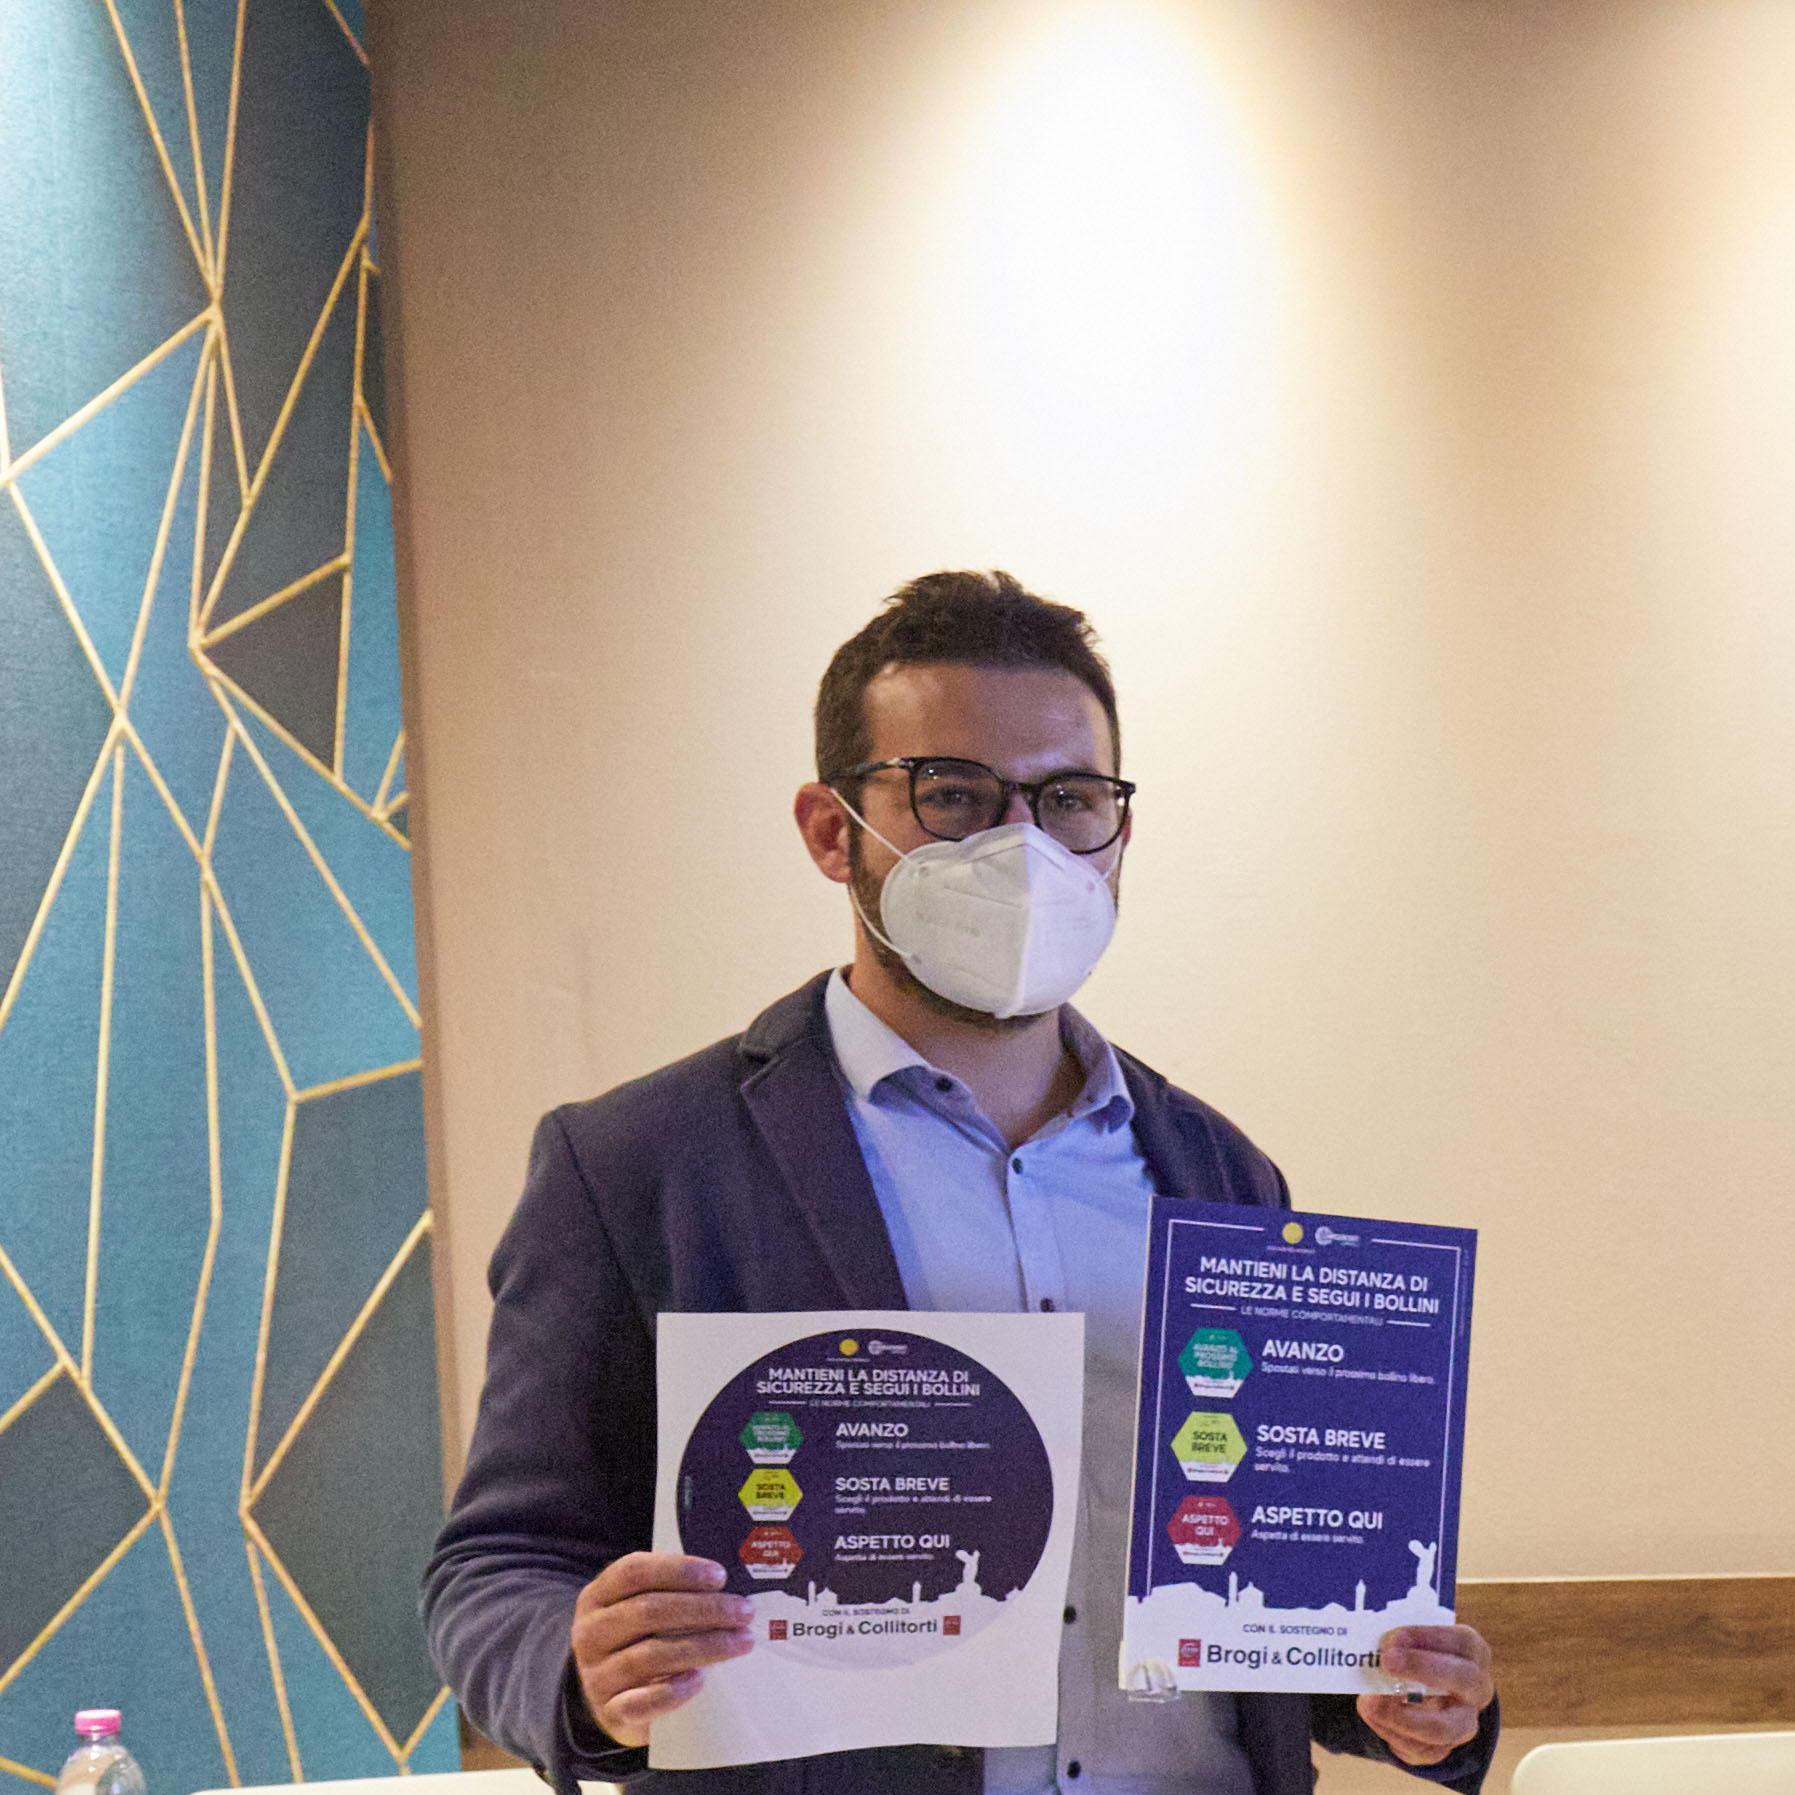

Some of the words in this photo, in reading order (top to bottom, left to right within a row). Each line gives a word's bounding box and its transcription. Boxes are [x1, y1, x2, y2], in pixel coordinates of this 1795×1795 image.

[1200, 1256, 1287, 1279] MANTIENI
[1291, 1265, 1315, 1282] LA
[1319, 1267, 1406, 1291] DISTANZA
[1410, 1276, 1428, 1292] DI
[1185, 1276, 1286, 1301] SICUREZZA
[1292, 1287, 1304, 1302] E
[1307, 1288, 1360, 1307] SEGUI
[1364, 1293, 1370, 1308] I
[1374, 1294, 1439, 1314] BOLLINI
[1254, 1307, 1289, 1319] NORME
[1262, 1340, 1344, 1362] AVANZO
[769, 1368, 845, 1381] MANTIENI
[848, 1369, 868, 1381] LA
[873, 1369, 949, 1383] DISTANZA
[952, 1370, 969, 1383] DI
[756, 1380, 845, 1395] SICUREZZA
[850, 1382, 860, 1395] E
[863, 1382, 910, 1396] SEGUI
[922, 1383, 981, 1397] BOLLINI
[836, 1422, 909, 1438] AVANZO
[1257, 1424, 1320, 1445] SOSTA
[1324, 1429, 1386, 1449] BREVE
[835, 1477, 891, 1492] SOSTA
[895, 1477, 949, 1492] BREVE
[1251, 1505, 1343, 1528] ASPETTO
[1348, 1510, 1383, 1530] QUI
[834, 1534, 915, 1550] ASPETTO
[919, 1534, 950, 1549] QUI
[792, 1623, 843, 1639] Brogi
[846, 1626, 855, 1635] &
[858, 1619, 937, 1636] Collitorti
[1243, 1623, 1265, 1634] CON
[1269, 1625, 1276, 1634] IL
[1279, 1625, 1335, 1636] SOSTEGNO
[1337, 1626, 1348, 1636] DI
[1207, 1644, 1268, 1669] Brogi
[1271, 1654, 1282, 1665] &
[1286, 1646, 1380, 1668] Collitorti
